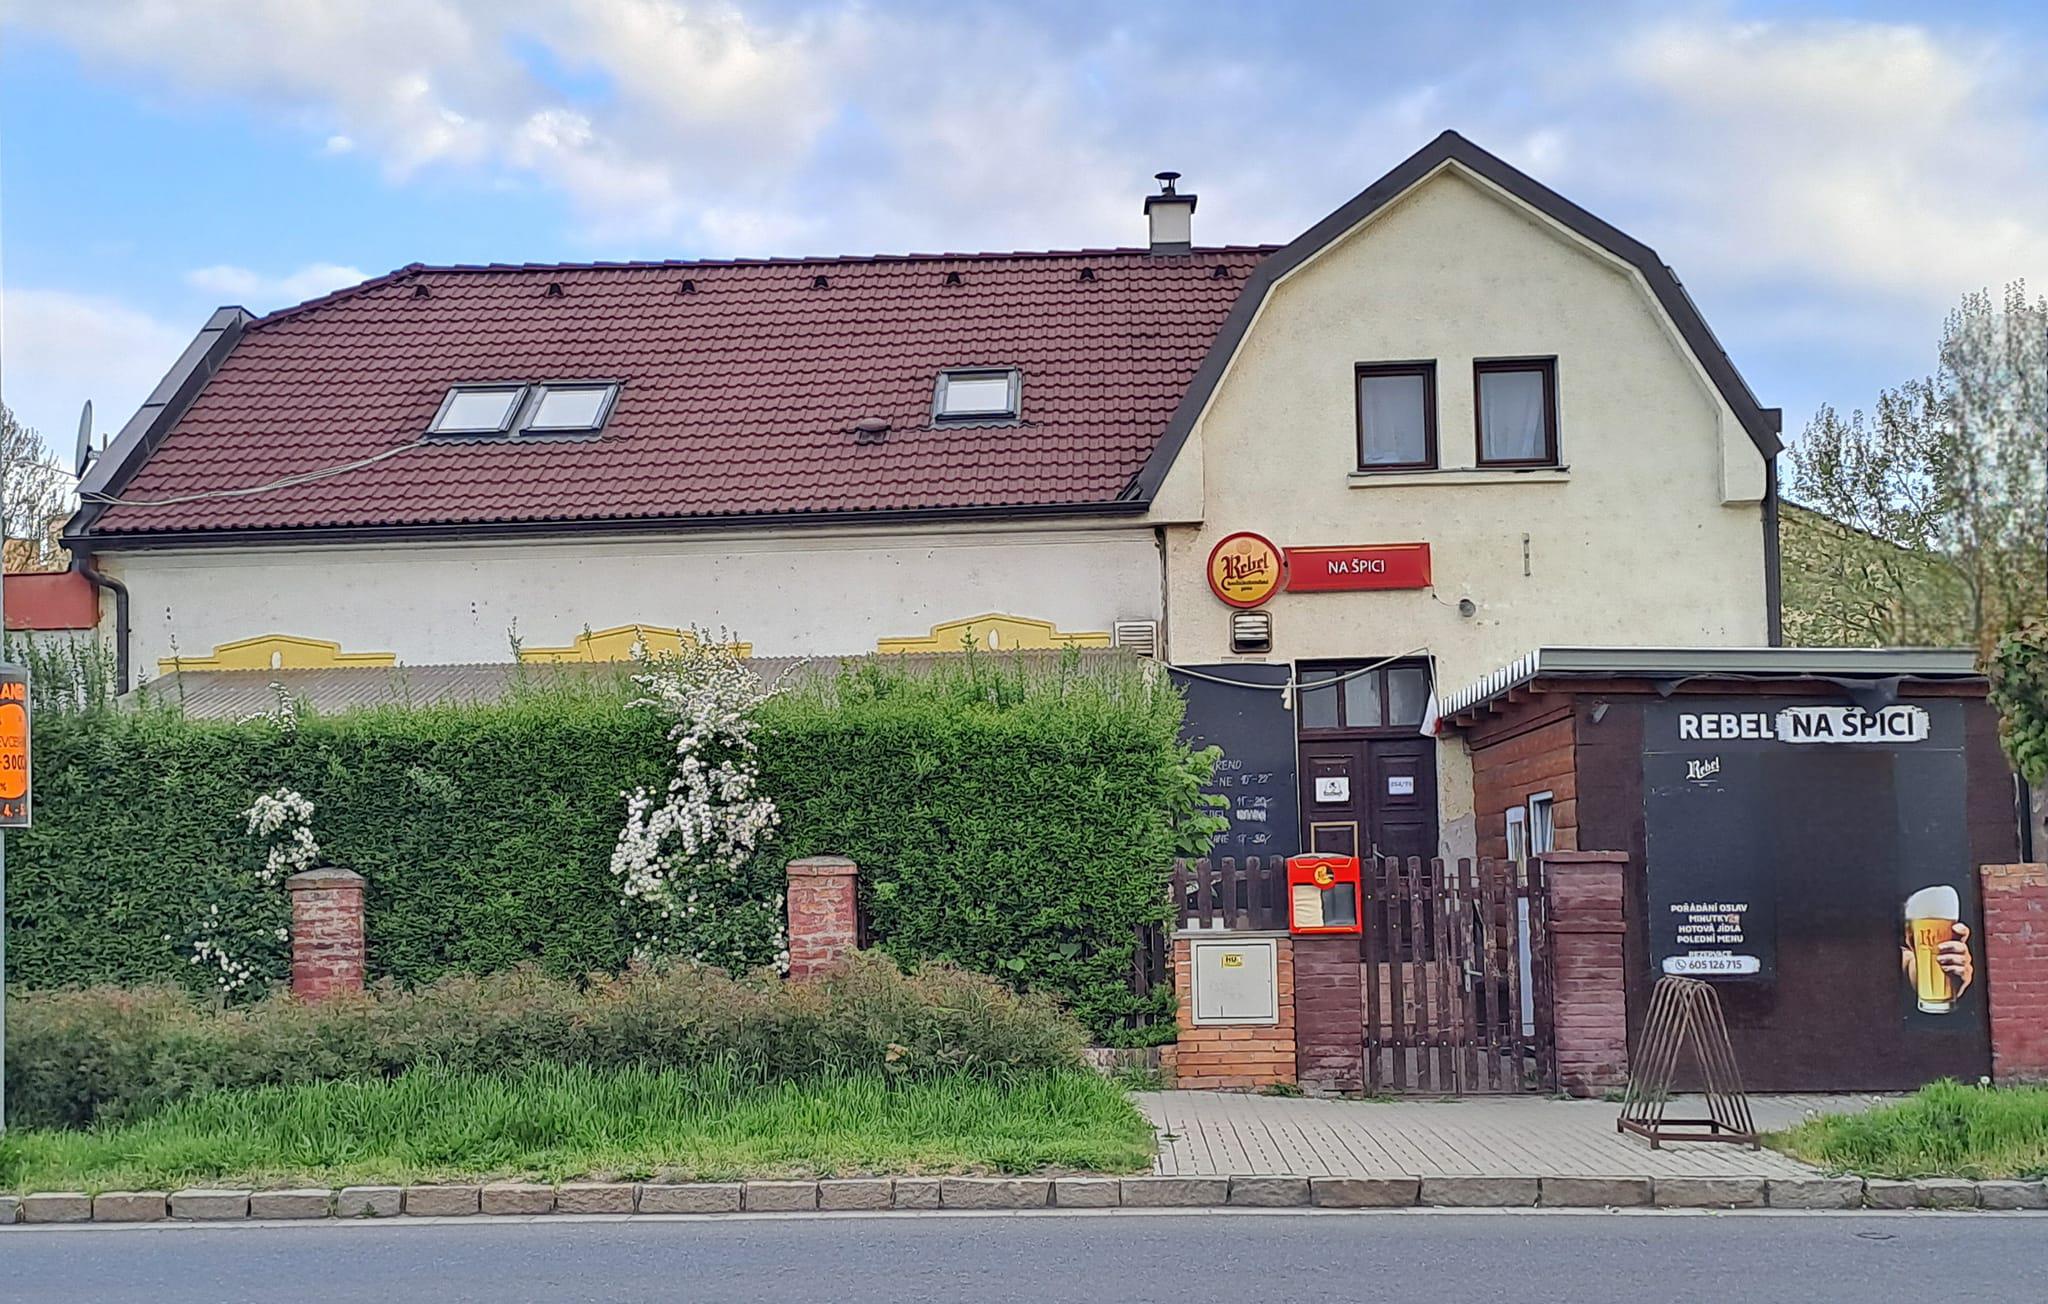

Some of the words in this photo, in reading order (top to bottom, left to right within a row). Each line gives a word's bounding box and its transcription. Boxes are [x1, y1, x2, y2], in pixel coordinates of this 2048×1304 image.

[1221, 552, 1270, 579] Rebel
[1328, 560, 1349, 574] NA
[1351, 558, 1386, 574] ŠPICI
[1679, 713, 1775, 740] REBEL
[1792, 713, 1834, 737] NA
[1841, 707, 1915, 737] ŠPICI
[1685, 757, 1721, 779] Rebel
[1670, 902, 1718, 913] POŘÁDÁNÍ
[1719, 904, 1748, 913] OSLAV
[1688, 914, 1729, 923] MINUTKY
[1678, 923, 1715, 933] HOTOVÁ
[1717, 923, 1742, 933] JÍDLA
[1676, 933, 1716, 943] POLEDNÍ
[1717, 934, 1744, 943] MENU
[1688, 960, 1707, 969] 605
[1710, 960, 1725, 969] 126
[1726, 960, 1743, 969] 715
